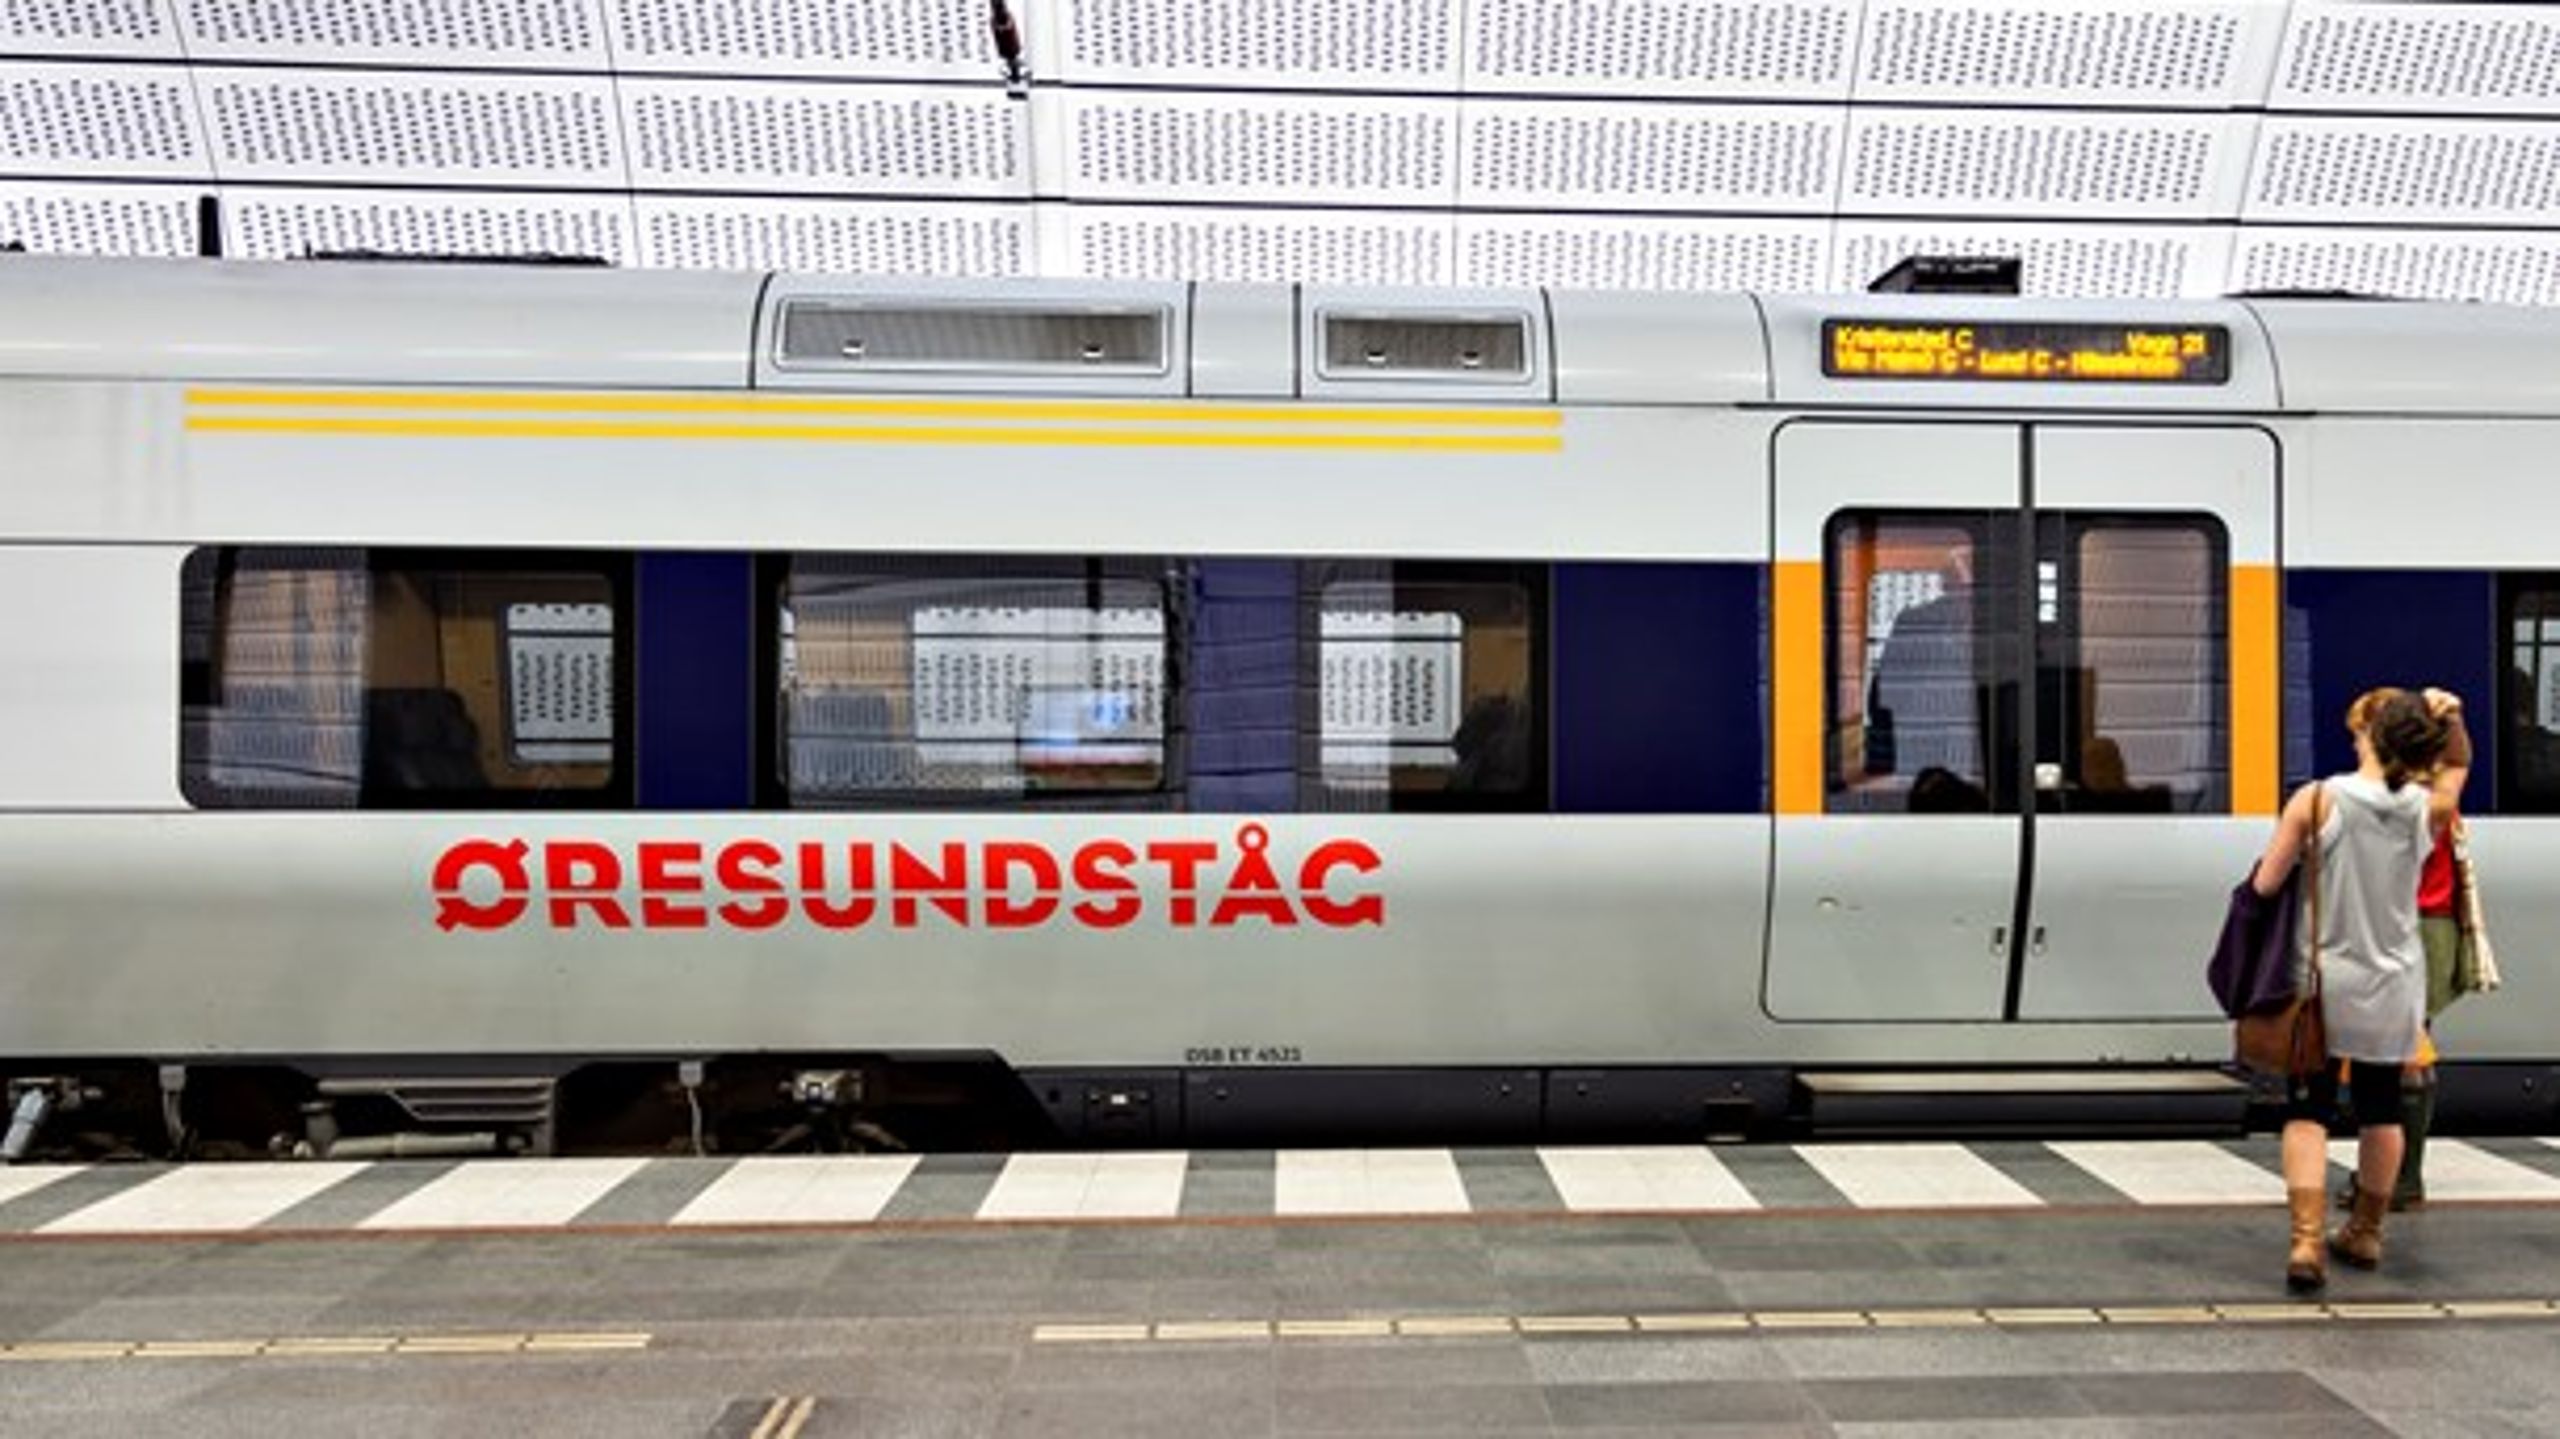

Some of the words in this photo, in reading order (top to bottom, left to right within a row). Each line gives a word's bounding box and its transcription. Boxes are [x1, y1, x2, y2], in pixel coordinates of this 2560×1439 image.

[432, 822, 1385, 931] ØRESUNDSTÅG
[1186, 1047, 1225, 1062] DSB
[1229, 1047, 1251, 1062] ET
